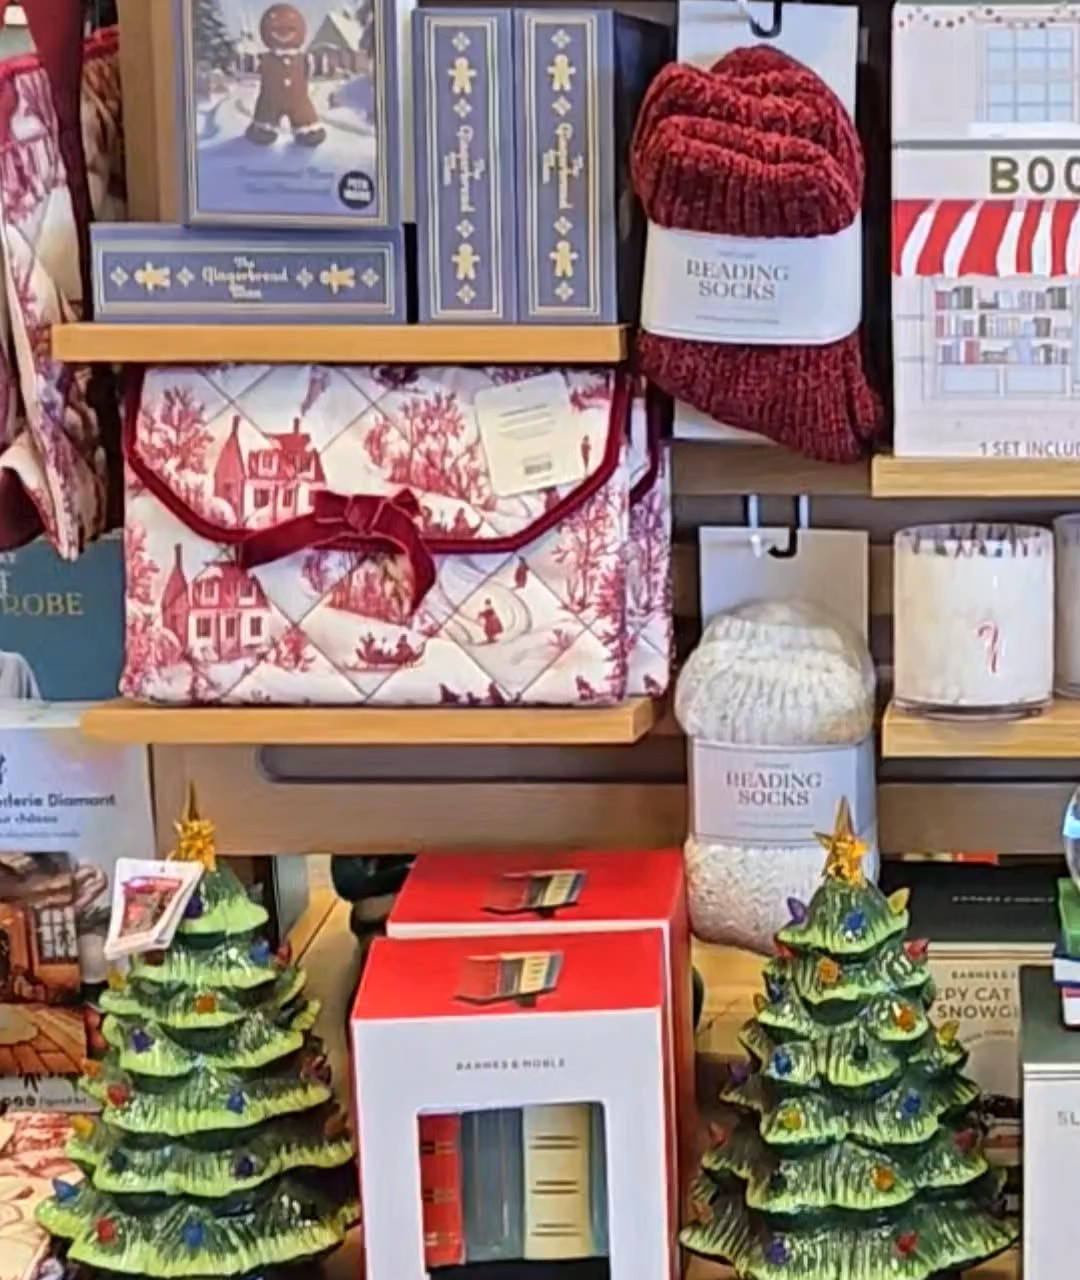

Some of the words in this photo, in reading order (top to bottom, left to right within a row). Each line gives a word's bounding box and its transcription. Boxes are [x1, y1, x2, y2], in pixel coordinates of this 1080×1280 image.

[686, 258, 790, 281] READING
[699, 279, 776, 300] SOCKS
[979, 441, 986, 457] 1
[992, 441, 1022, 457] SET
[726, 771, 822, 789] READING
[738, 788, 809, 806] SOCKS
[974, 987, 1011, 1001] CAT
